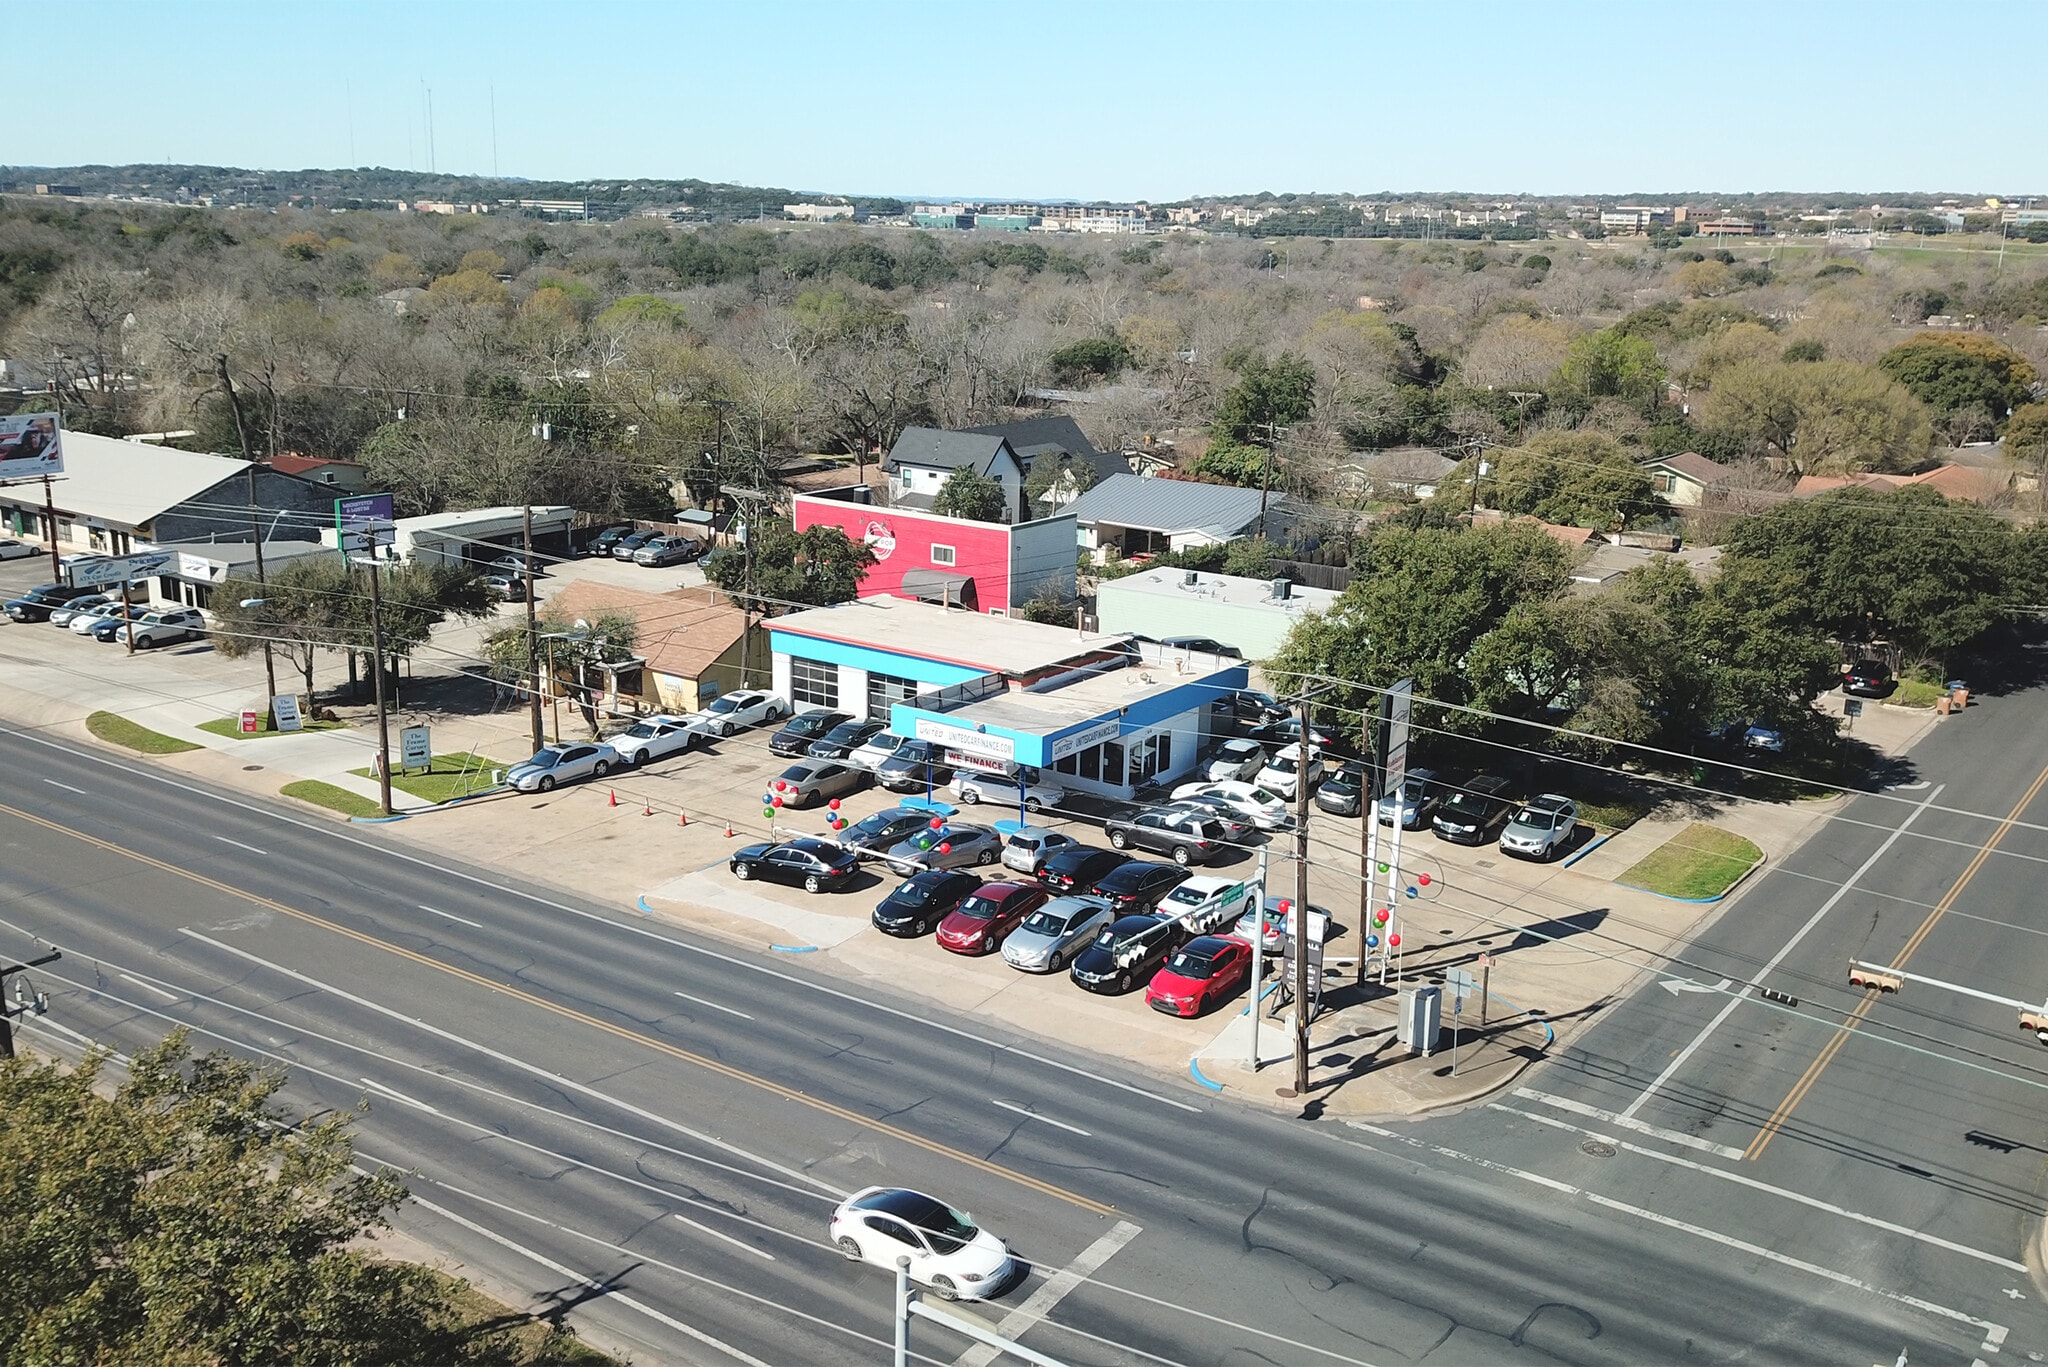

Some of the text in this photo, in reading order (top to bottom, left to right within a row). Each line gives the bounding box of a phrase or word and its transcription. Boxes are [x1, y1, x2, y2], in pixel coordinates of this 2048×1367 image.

[919, 726, 1013, 754] UNITED UNITEDCARFINANCE.COM
[948, 751, 1004, 771] WE FINANCE
